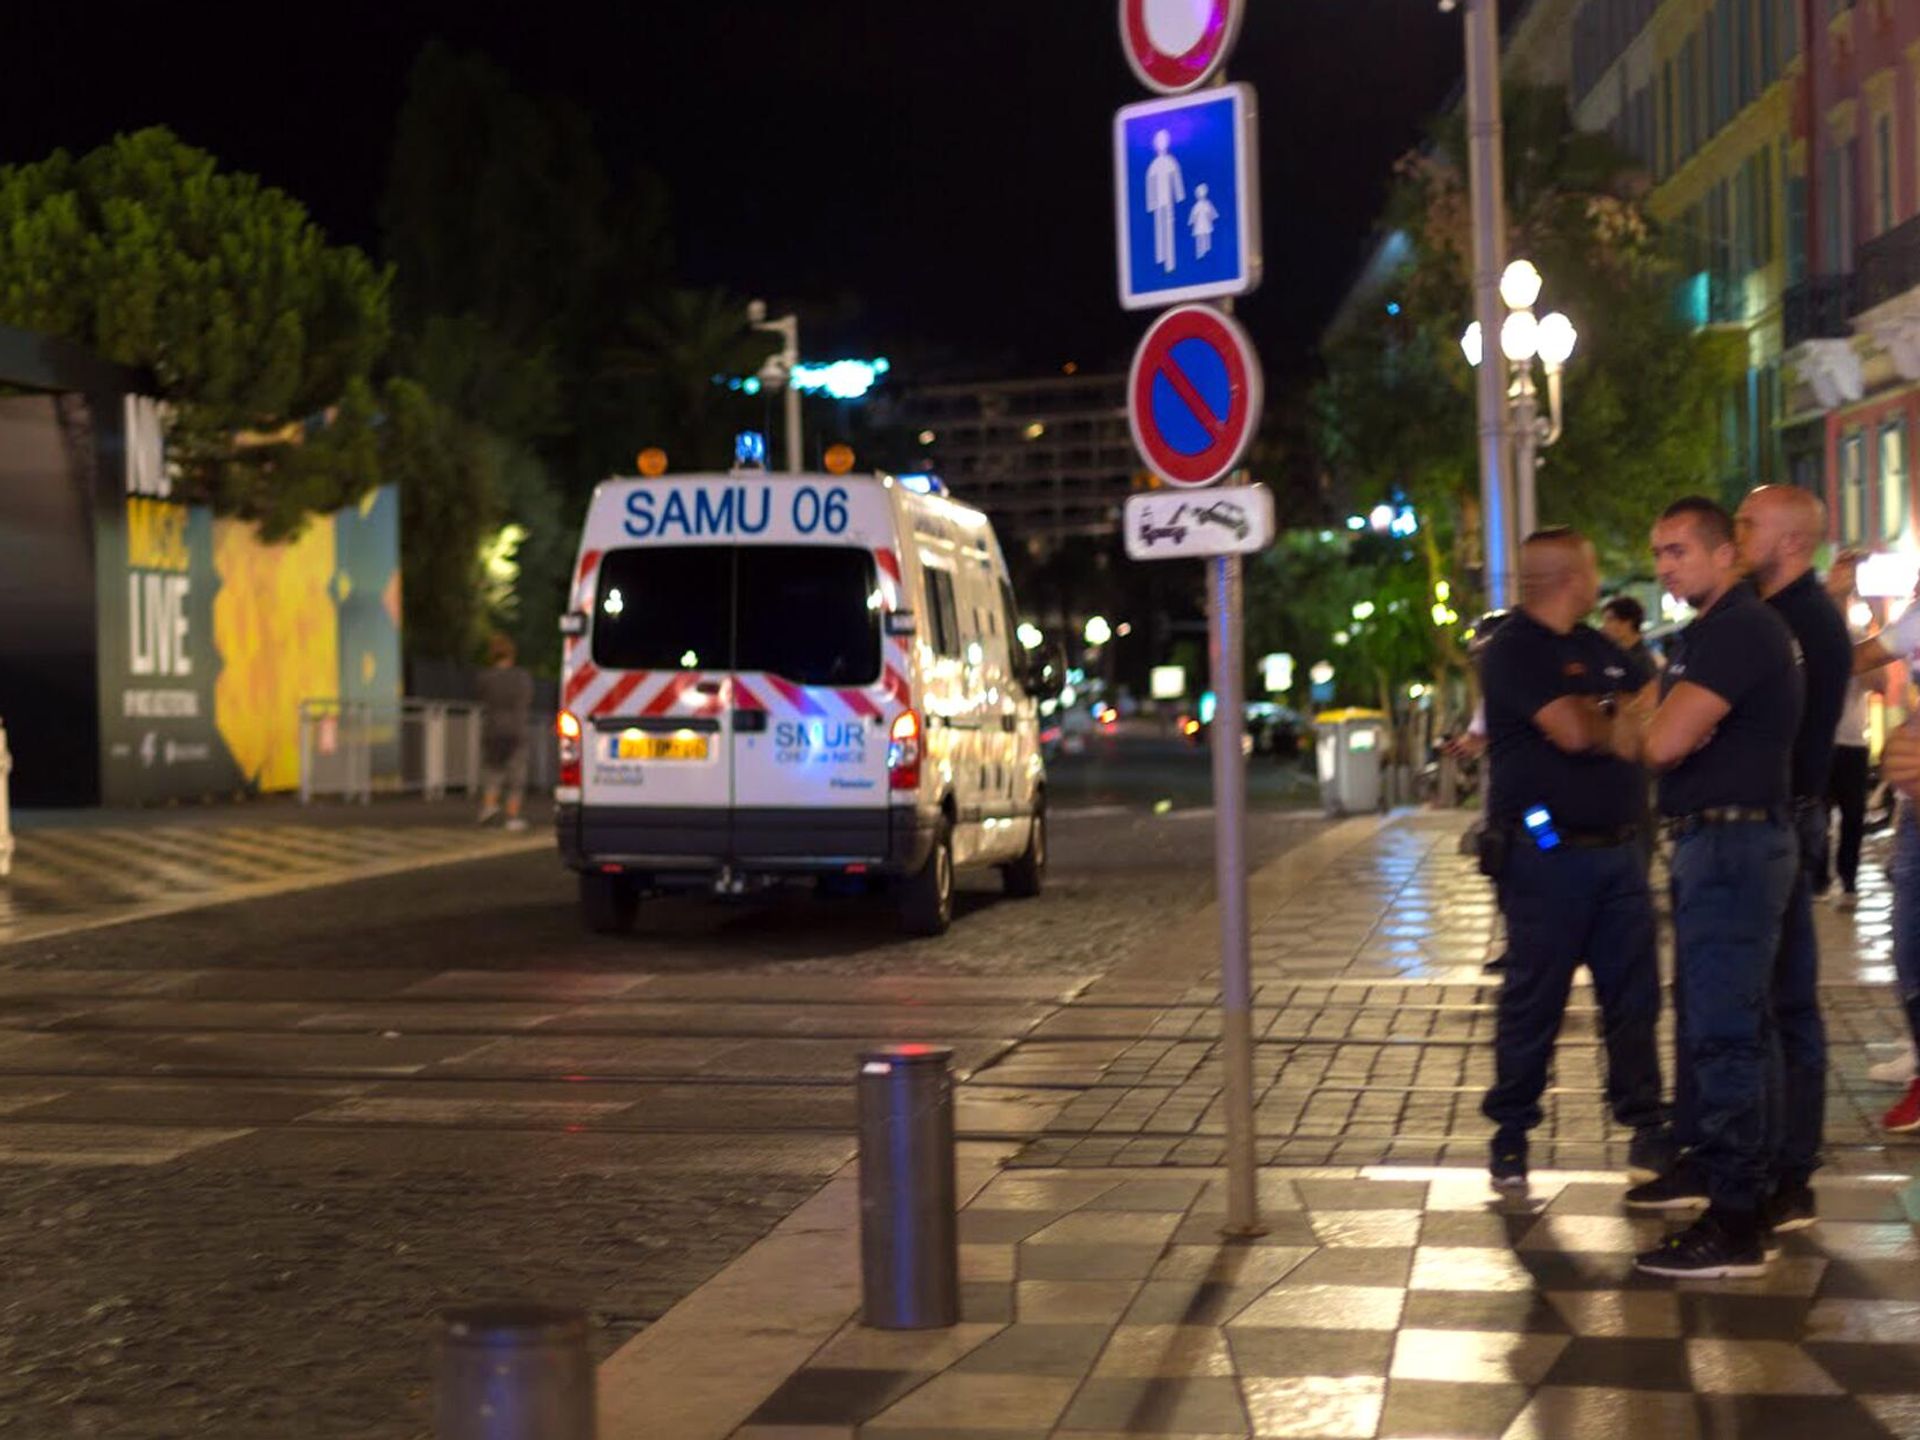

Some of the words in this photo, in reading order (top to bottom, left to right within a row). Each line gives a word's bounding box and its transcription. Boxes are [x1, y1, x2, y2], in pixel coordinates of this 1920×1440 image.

[624, 487, 771, 537] SAMU
[792, 485, 848, 535] 06
[129, 572, 192, 677] LIVE
